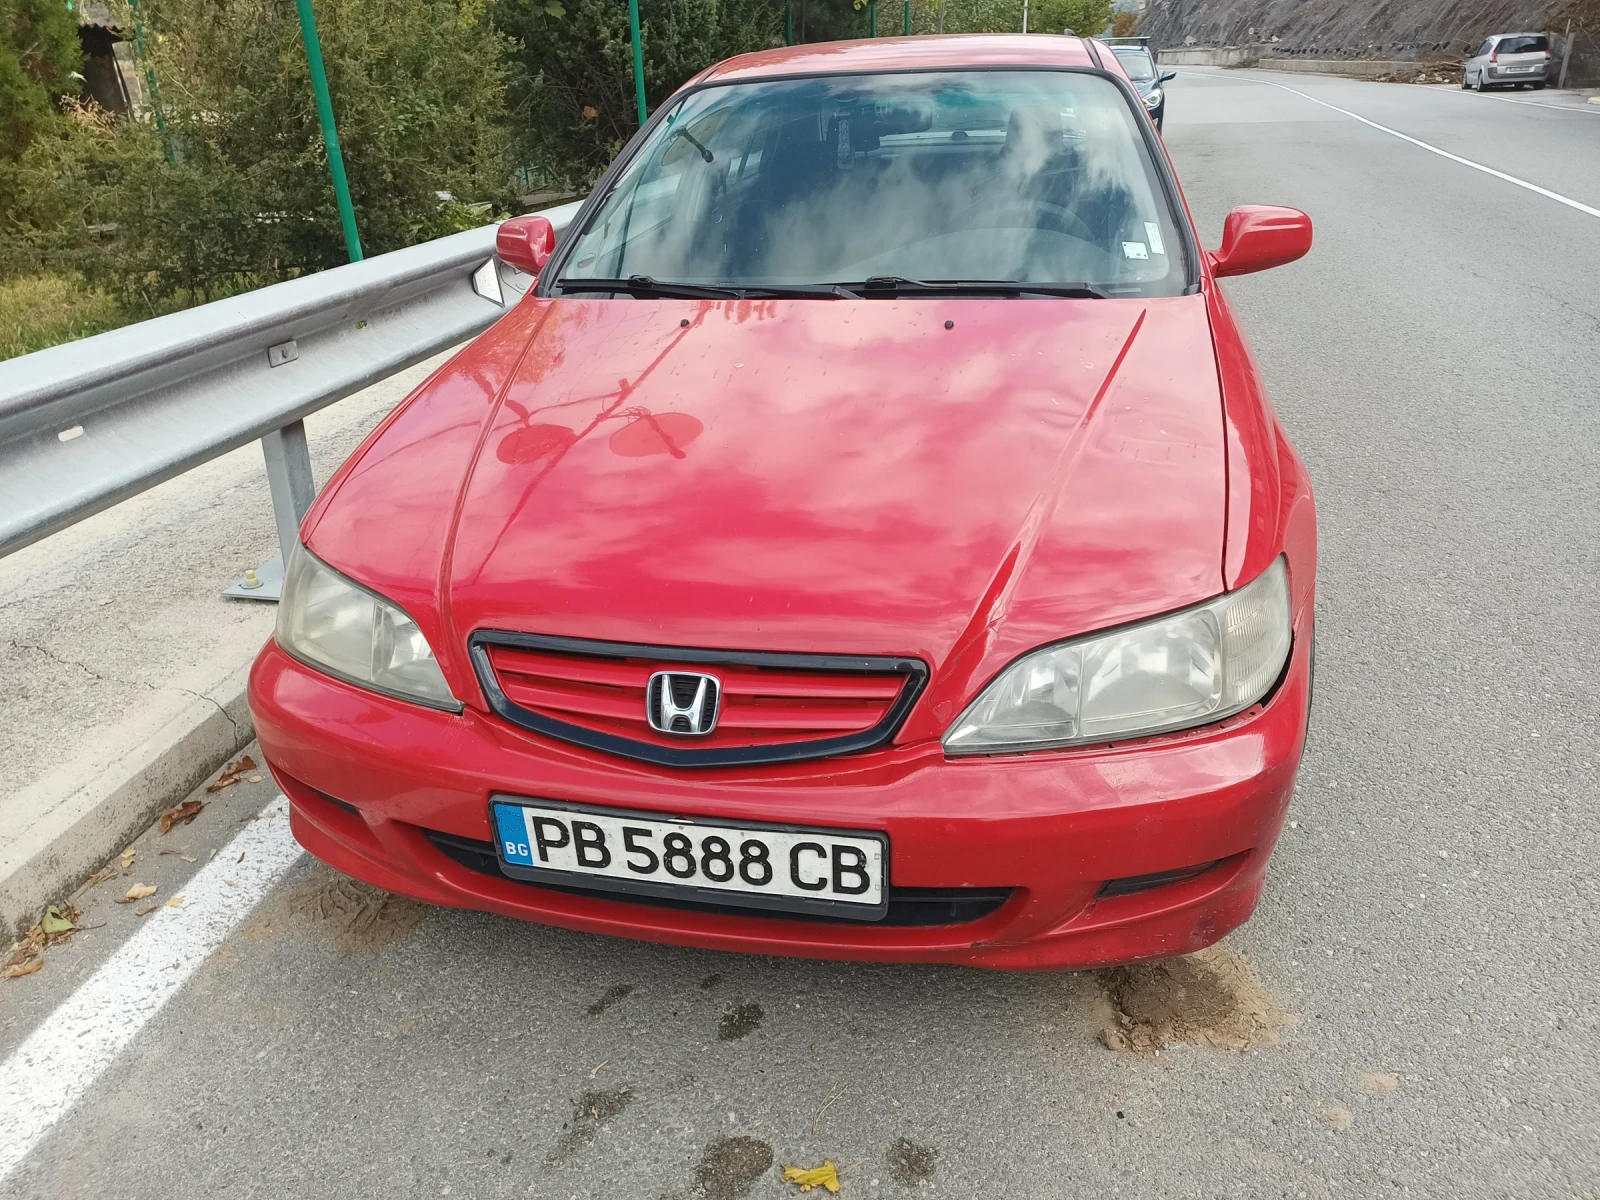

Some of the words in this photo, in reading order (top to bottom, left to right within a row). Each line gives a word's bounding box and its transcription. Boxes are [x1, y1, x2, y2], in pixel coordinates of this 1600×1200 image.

[505, 841, 529, 857] BG
[532, 815, 612, 869] PB
[622, 826, 773, 886] 5888
[789, 841, 871, 895] CB
